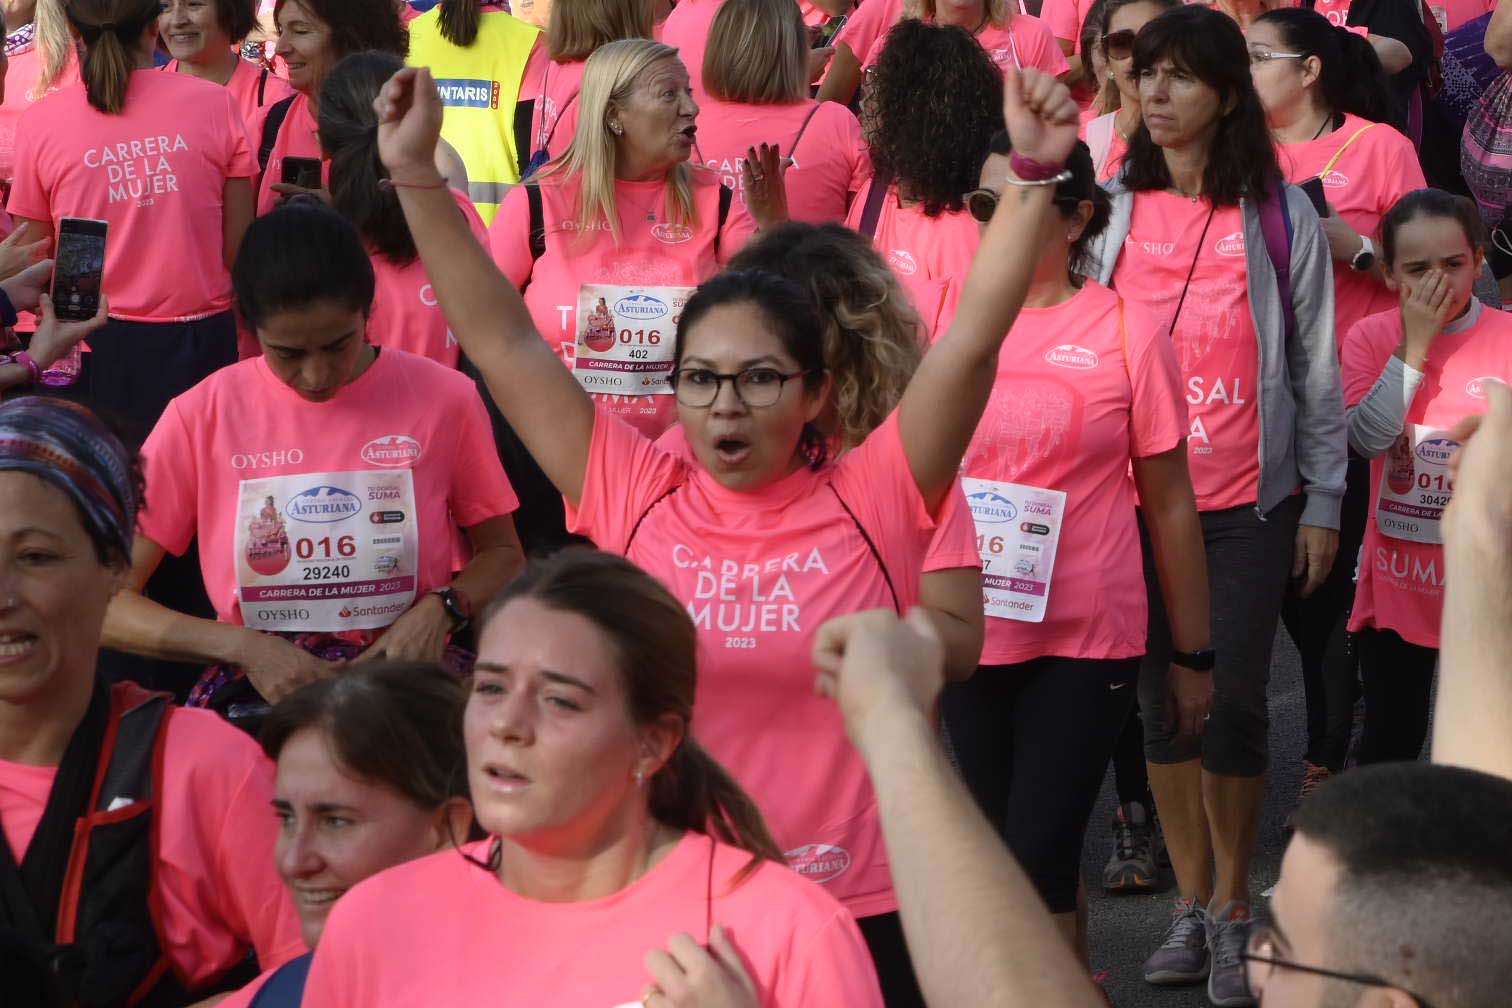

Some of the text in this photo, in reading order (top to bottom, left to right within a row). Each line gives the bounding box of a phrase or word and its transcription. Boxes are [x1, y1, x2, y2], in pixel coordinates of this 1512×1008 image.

[83, 133, 189, 169] CARRERA
[108, 154, 173, 184] DE LA
[107, 173, 181, 205] MUJER
[618, 303, 664, 314] ASTURIANA
[620, 329, 660, 344] 016
[629, 349, 647, 359] 402
[1050, 353, 1097, 365] ASTURIANA
[584, 376, 622, 386] OYSHO
[231, 449, 304, 469] OYSHO
[368, 492, 401, 500] SUMA
[291, 501, 356, 515] ASTURIANA
[1024, 505, 1051, 515] SUMA
[1385, 518, 1419, 533] OYSHO
[296, 535, 356, 559] 016
[303, 565, 350, 580] 29240
[1376, 547, 1444, 586] SUM
[695, 571, 795, 602] DE LA
[984, 577, 1034, 590] MUJER 2023
[260, 588, 307, 598] CARRERA
[309, 587, 323, 597] DE
[325, 586, 338, 596] LA
[340, 584, 375, 594] MUJER
[353, 602, 406, 616] Santander
[991, 597, 1034, 611] Santander
[258, 609, 309, 621] OYSHO
[686, 604, 802, 632] MUJER
[725, 637, 756, 648] 2023
